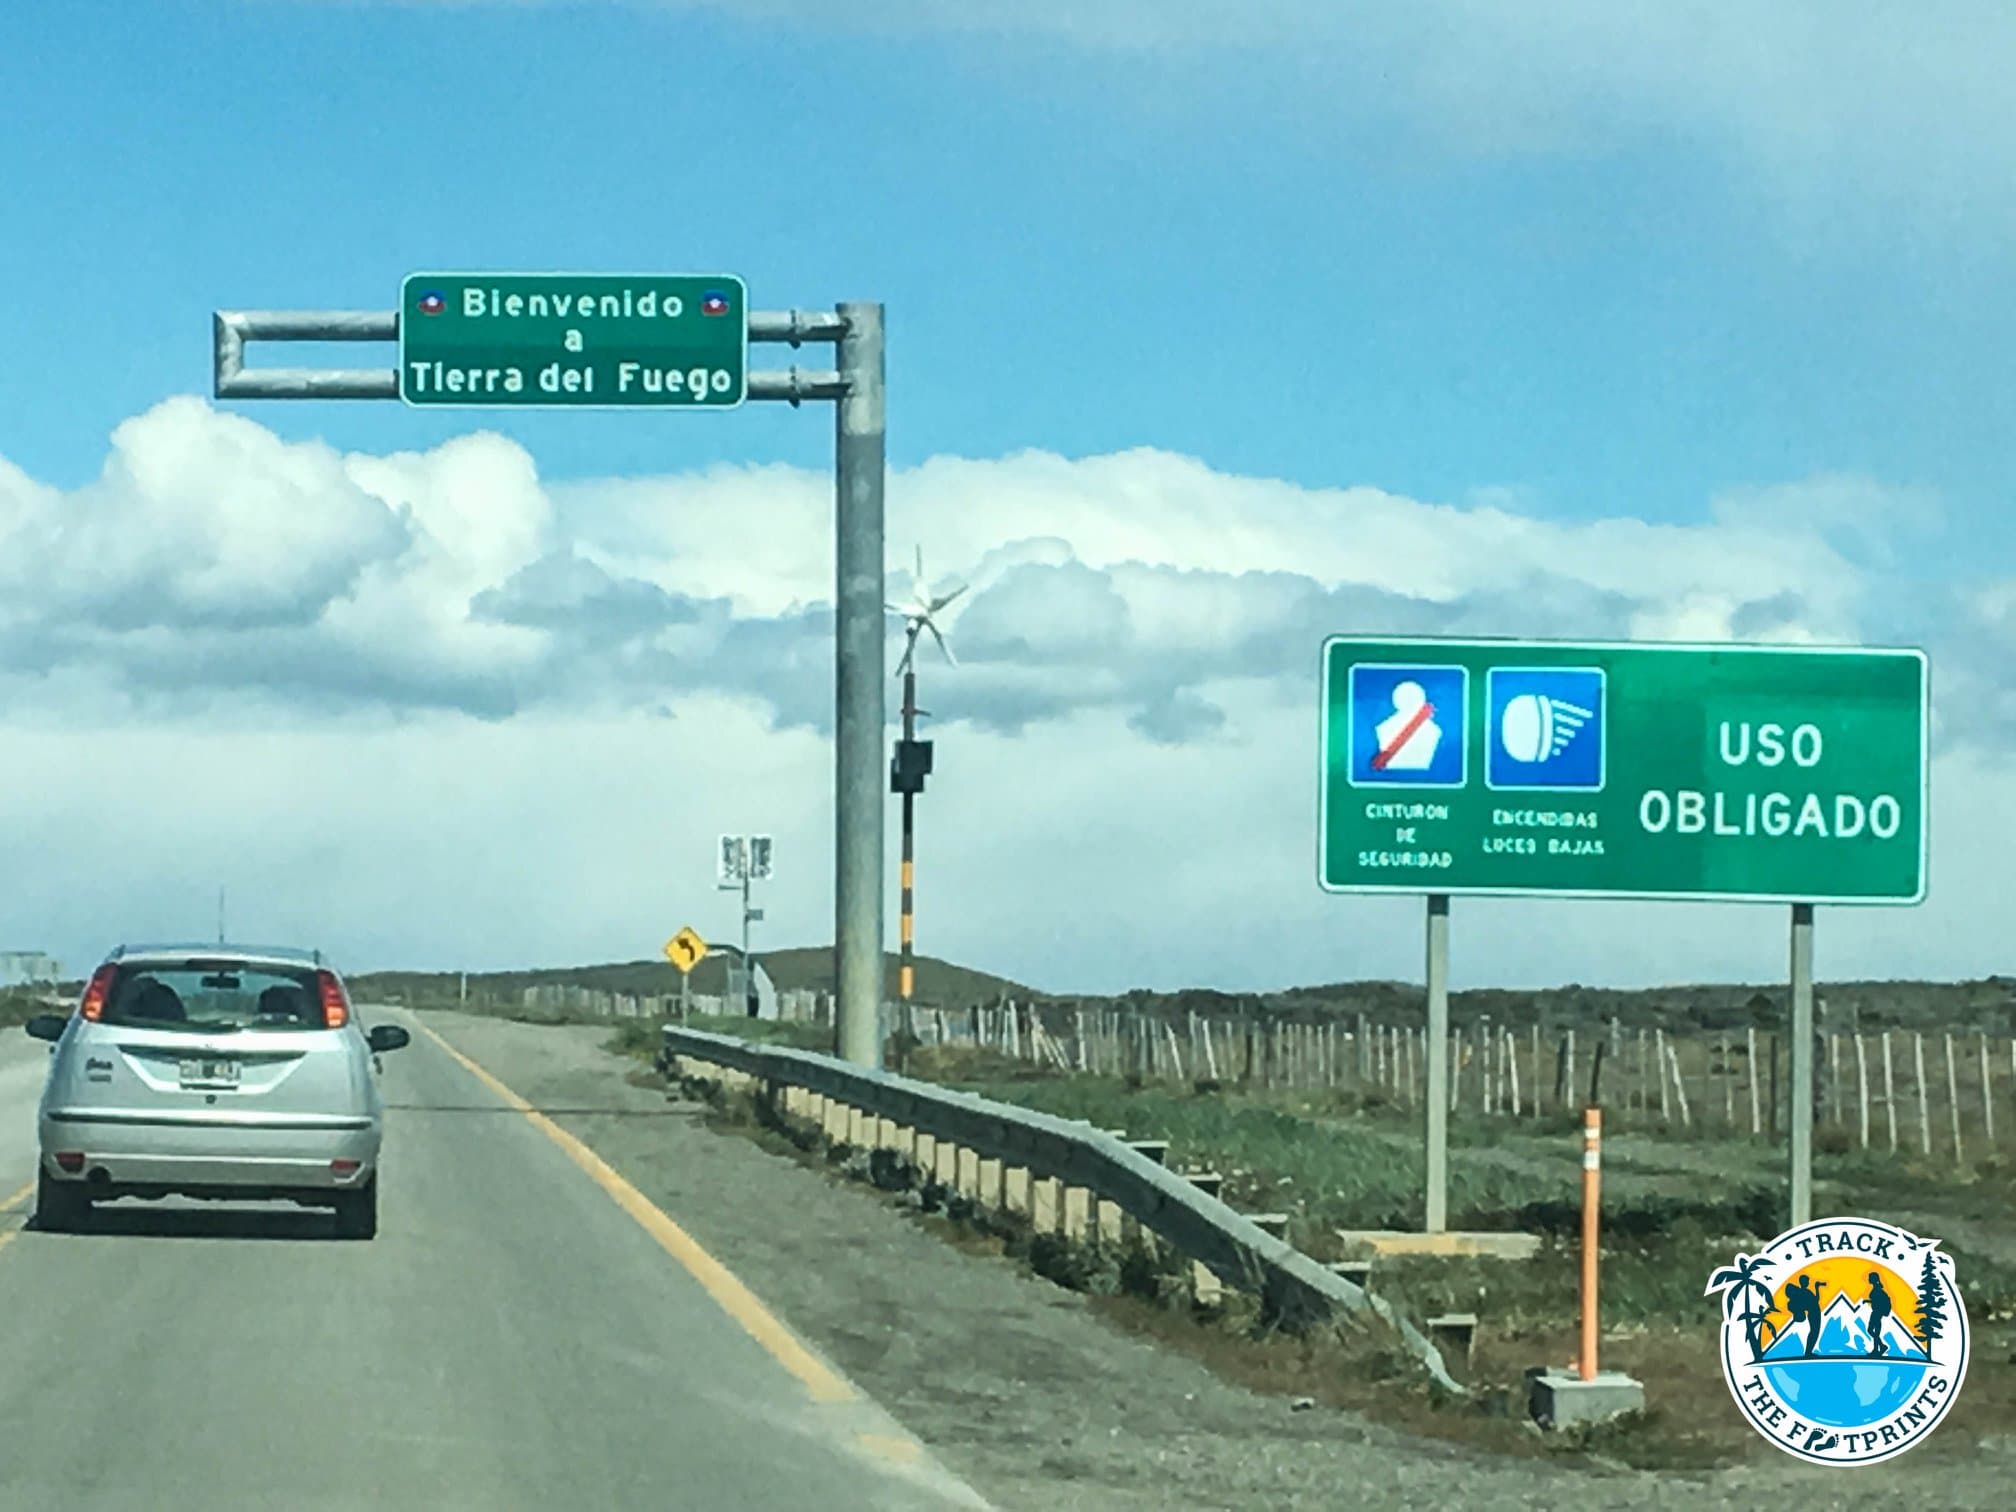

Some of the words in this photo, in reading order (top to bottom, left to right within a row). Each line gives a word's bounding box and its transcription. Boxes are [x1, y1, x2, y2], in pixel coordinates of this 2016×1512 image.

[463, 287, 684, 318] Bienvenido
[564, 328, 584, 352] a
[410, 361, 524, 393] Tierra
[538, 361, 594, 393] del
[618, 361, 732, 401] Fuego
[1719, 721, 1823, 768] USO
[1365, 803, 1449, 820] CINTURON
[1639, 789, 1901, 839] OBLIGADO
[1395, 827, 1416, 844] DE
[1482, 837, 1537, 855] LUCES
[1548, 838, 1605, 855] BAJAS
[1358, 850, 1453, 869] SEGURIDAD
